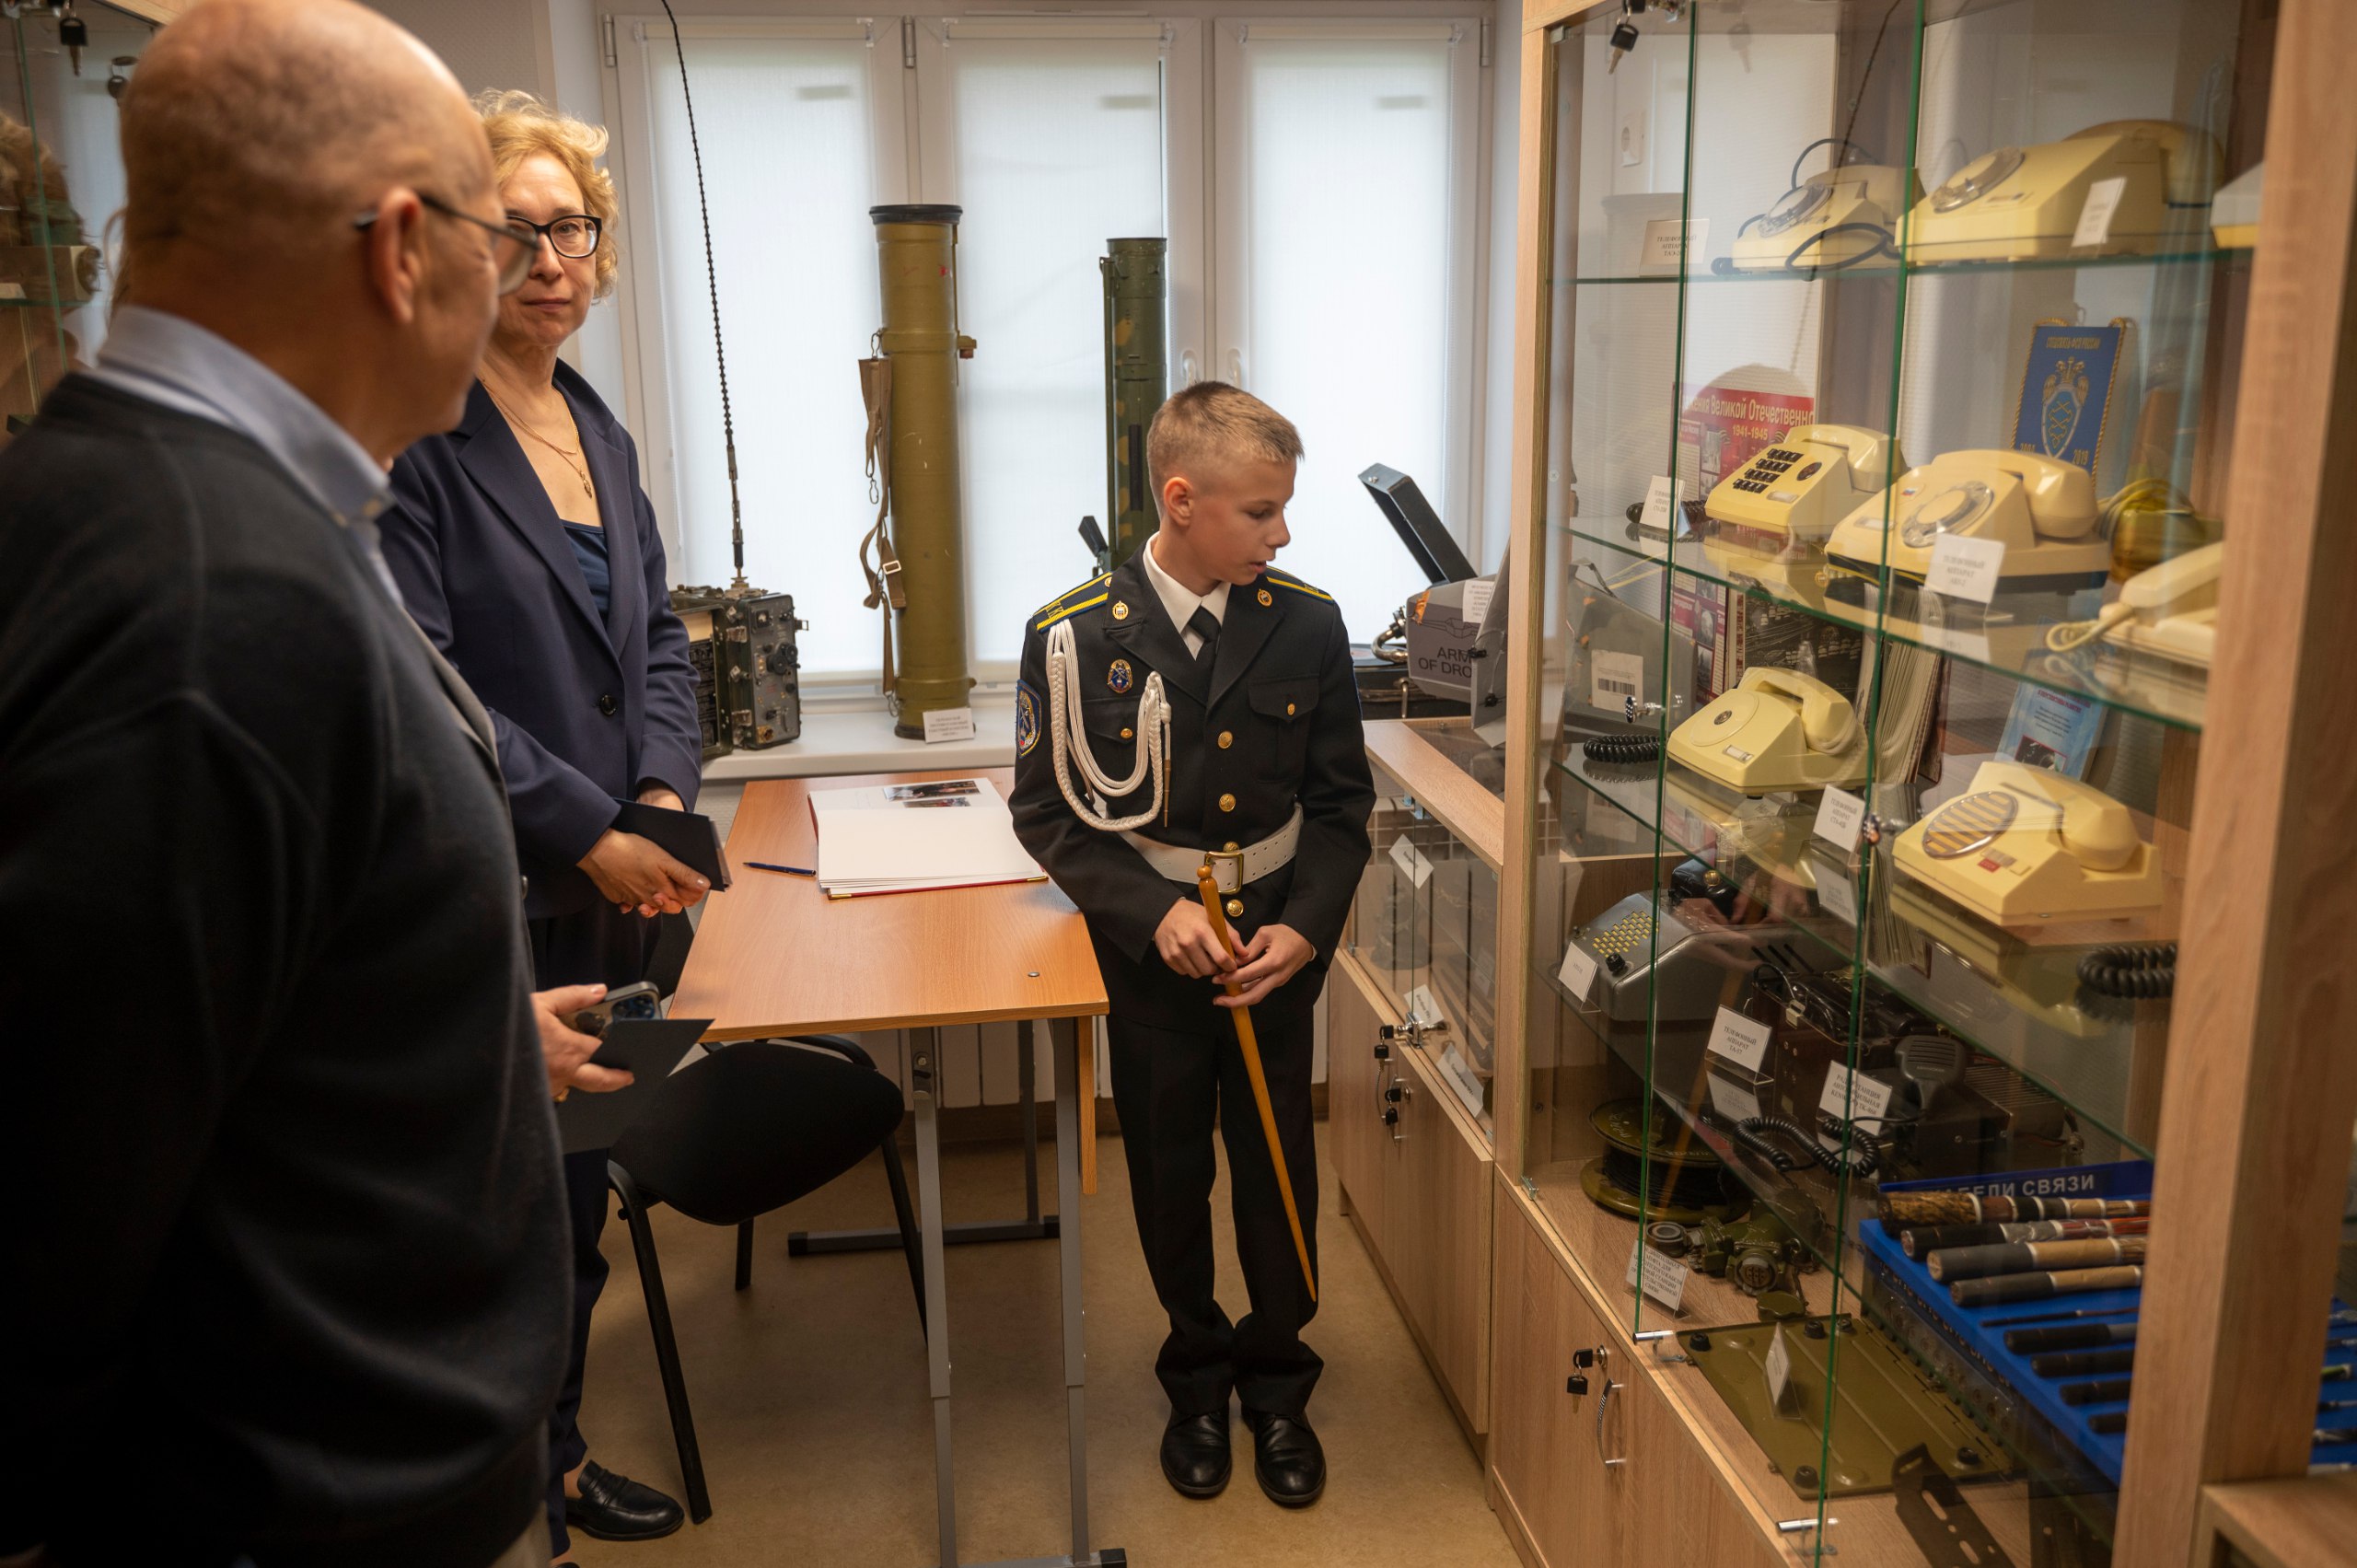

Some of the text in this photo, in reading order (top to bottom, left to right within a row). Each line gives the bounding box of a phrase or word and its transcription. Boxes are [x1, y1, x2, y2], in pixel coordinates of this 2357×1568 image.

[1711, 395, 1746, 419] Великой
[1749, 400, 1815, 427] Отечественно
[1437, 646, 1472, 664] ARM
[1419, 657, 1472, 679] OF DRO
[1724, 1025, 1758, 1046] ТЕЛЕФОННЫЙ
[1727, 1036, 1749, 1051] АППАРАТ
[2022, 1174, 2095, 1196] СВЯЗИ
